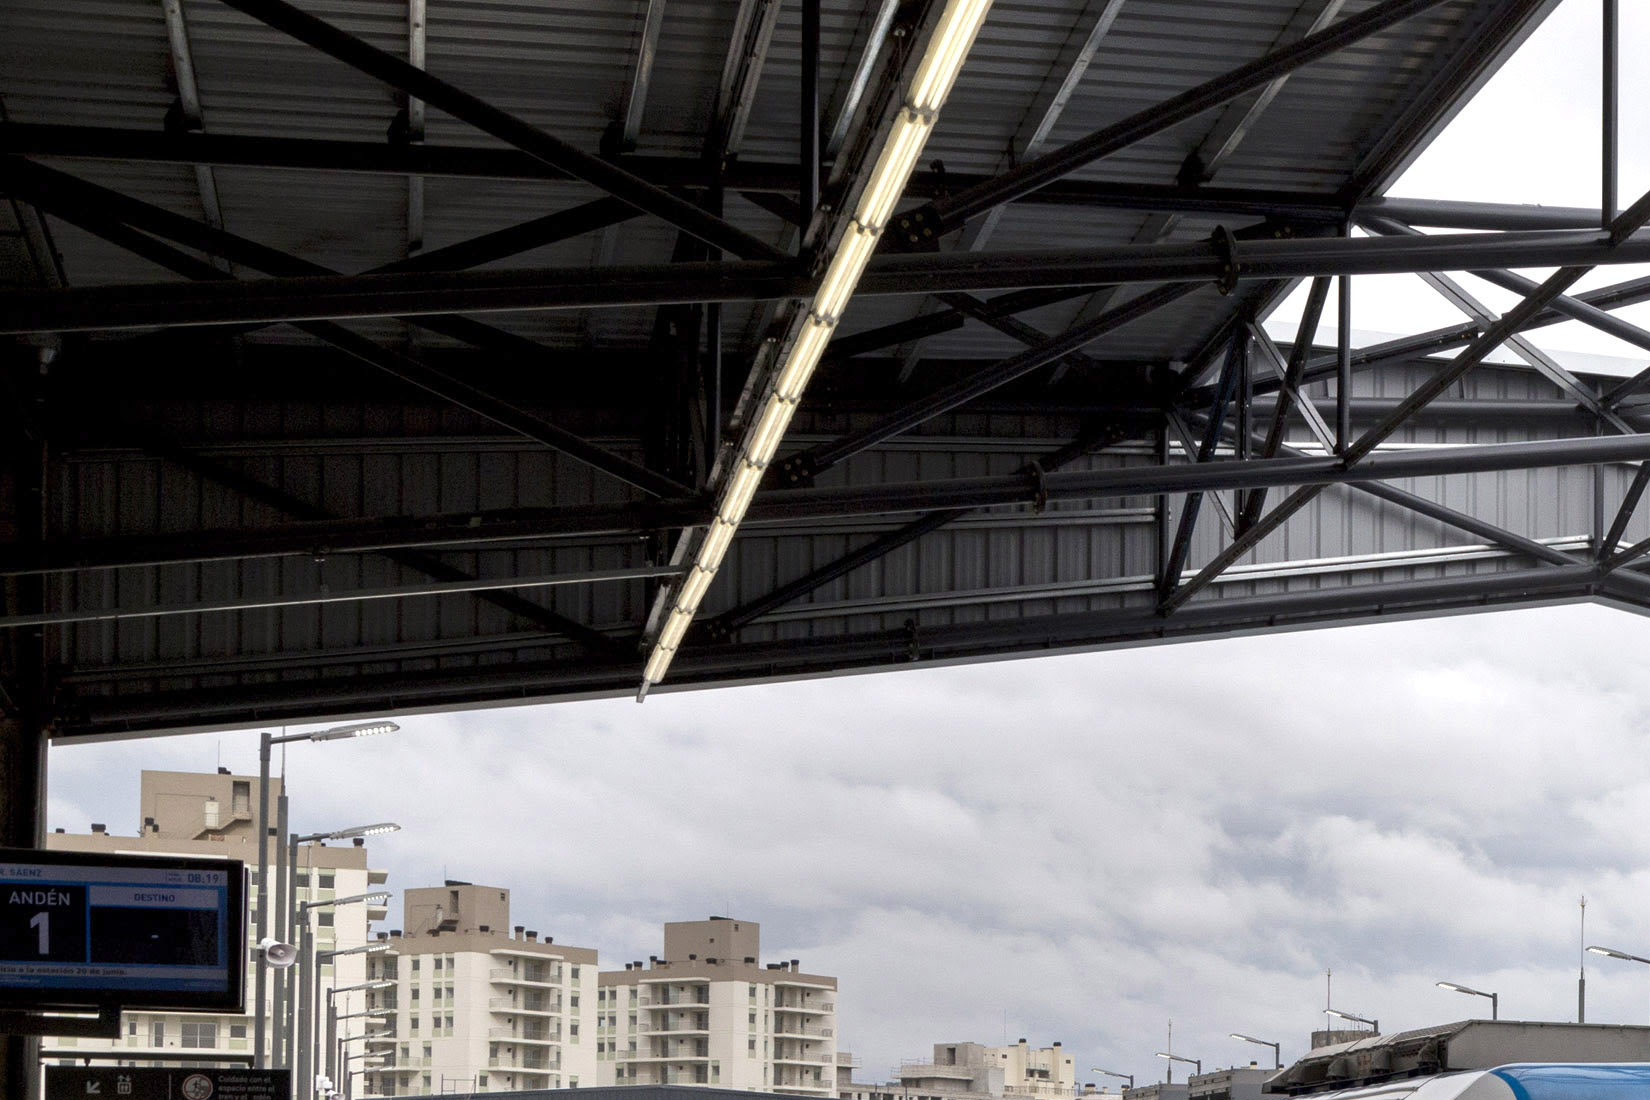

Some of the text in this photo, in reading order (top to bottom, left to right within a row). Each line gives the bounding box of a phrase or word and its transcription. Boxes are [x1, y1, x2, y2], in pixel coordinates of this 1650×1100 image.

[187, 873, 220, 884] 08:19
[9, 889, 71, 906] ANDÉN
[134, 893, 176, 903] DESTINO
[30, 911, 50, 955] 1
